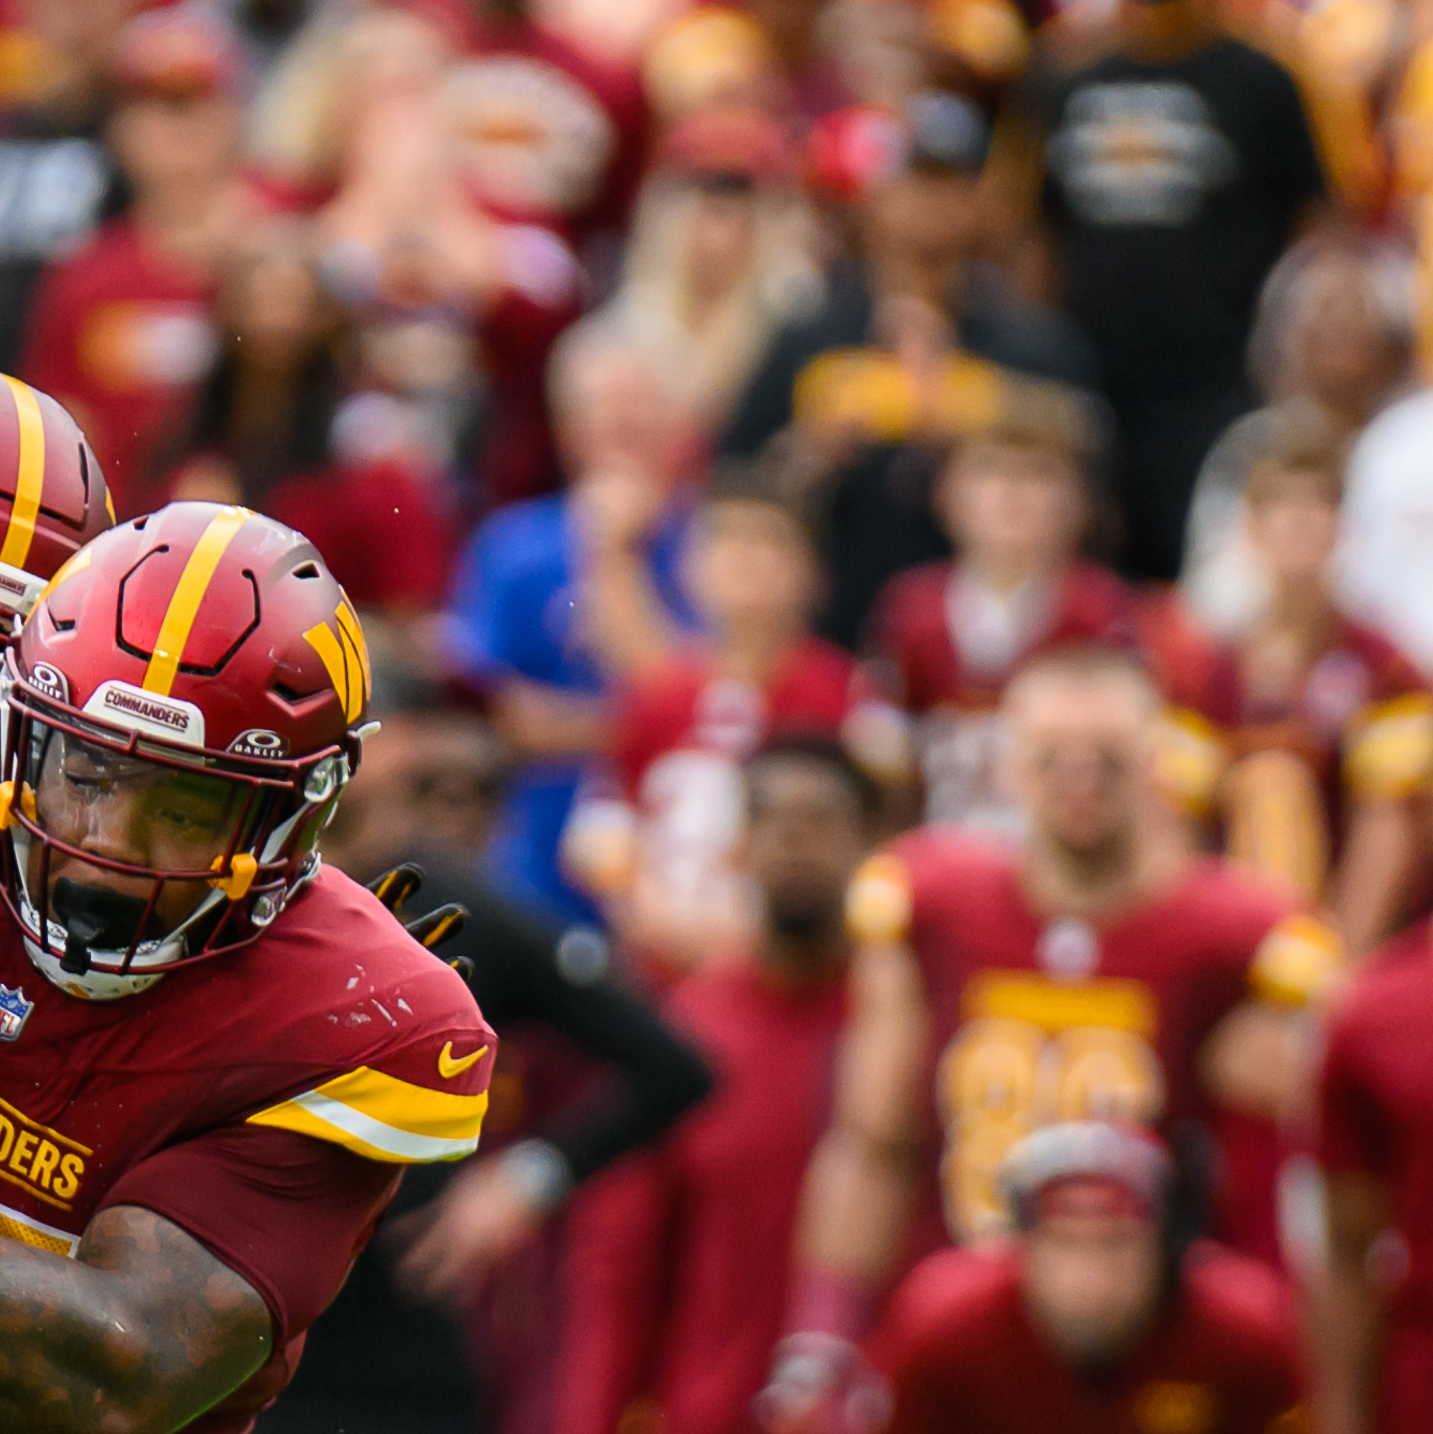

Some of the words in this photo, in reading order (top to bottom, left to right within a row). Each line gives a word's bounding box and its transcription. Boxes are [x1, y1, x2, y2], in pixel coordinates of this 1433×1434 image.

[28, 674, 63, 701] OAKLEY
[103, 689, 190, 730] COMMANDERS
[234, 742, 286, 759] OAKLEY
